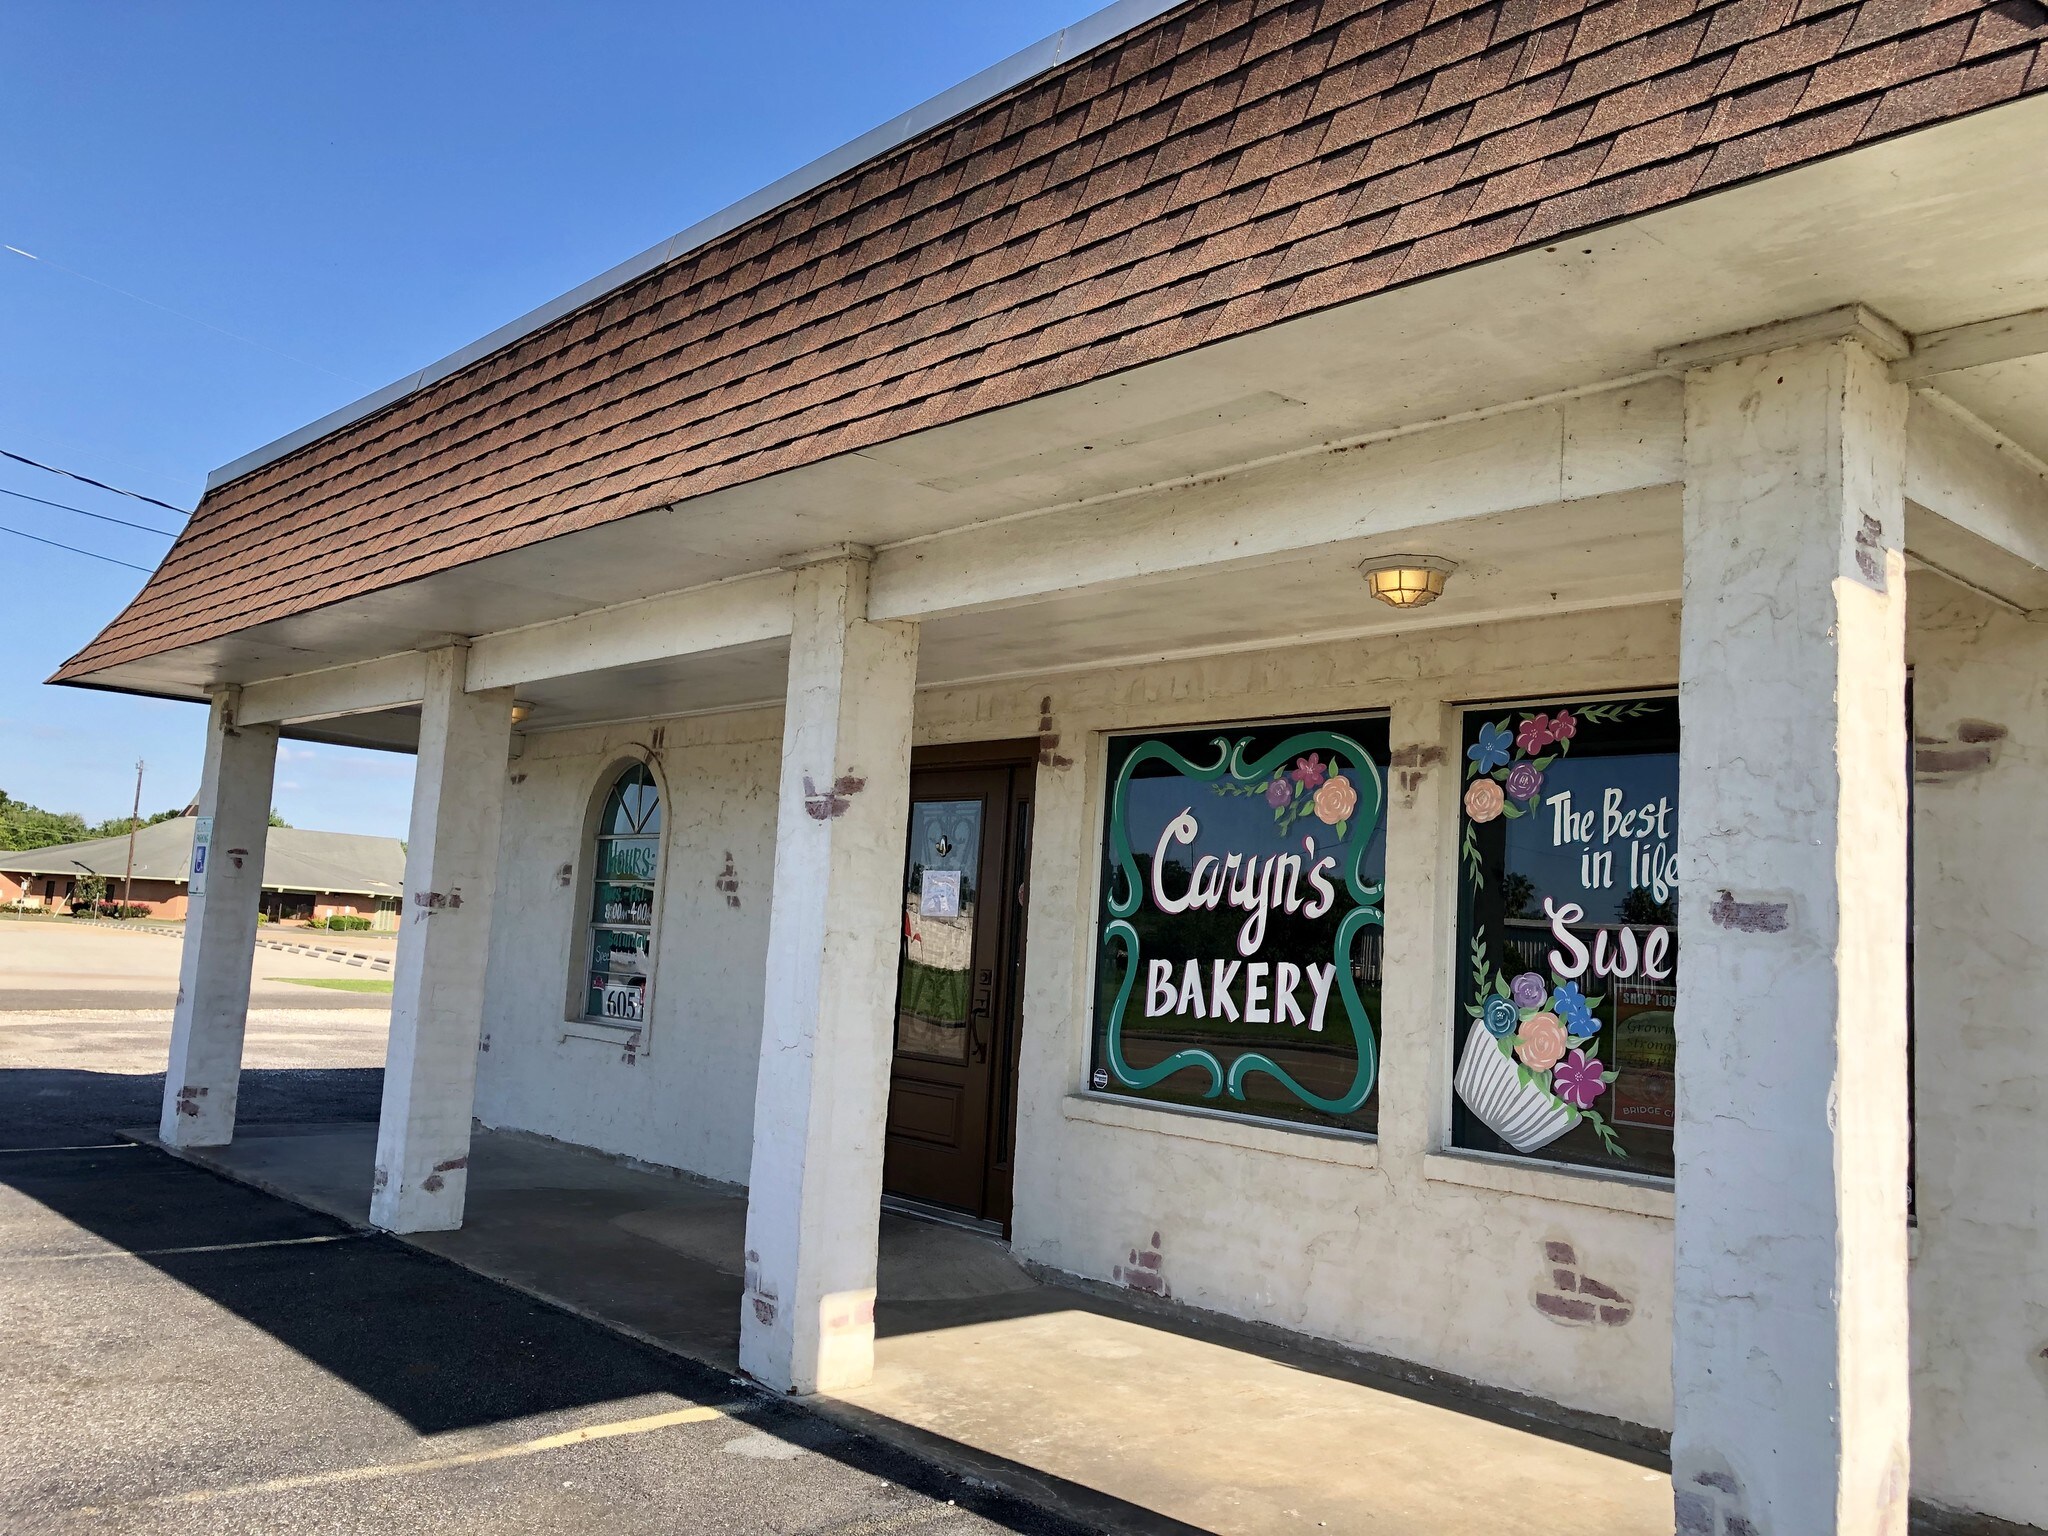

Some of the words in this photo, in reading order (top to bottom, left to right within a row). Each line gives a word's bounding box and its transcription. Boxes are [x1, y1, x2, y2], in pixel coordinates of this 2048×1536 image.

[1546, 790, 1595, 846] The
[1602, 787, 1673, 845] Best
[1150, 806, 1337, 958] Caryn's
[1581, 846, 1614, 889] in
[1630, 840, 1679, 905] life
[607, 990, 636, 1018] 605
[1145, 958, 1337, 1032] BAKERY
[1623, 992, 1652, 1006] SHOP
[1622, 1106, 1662, 1116] BRIDGE
